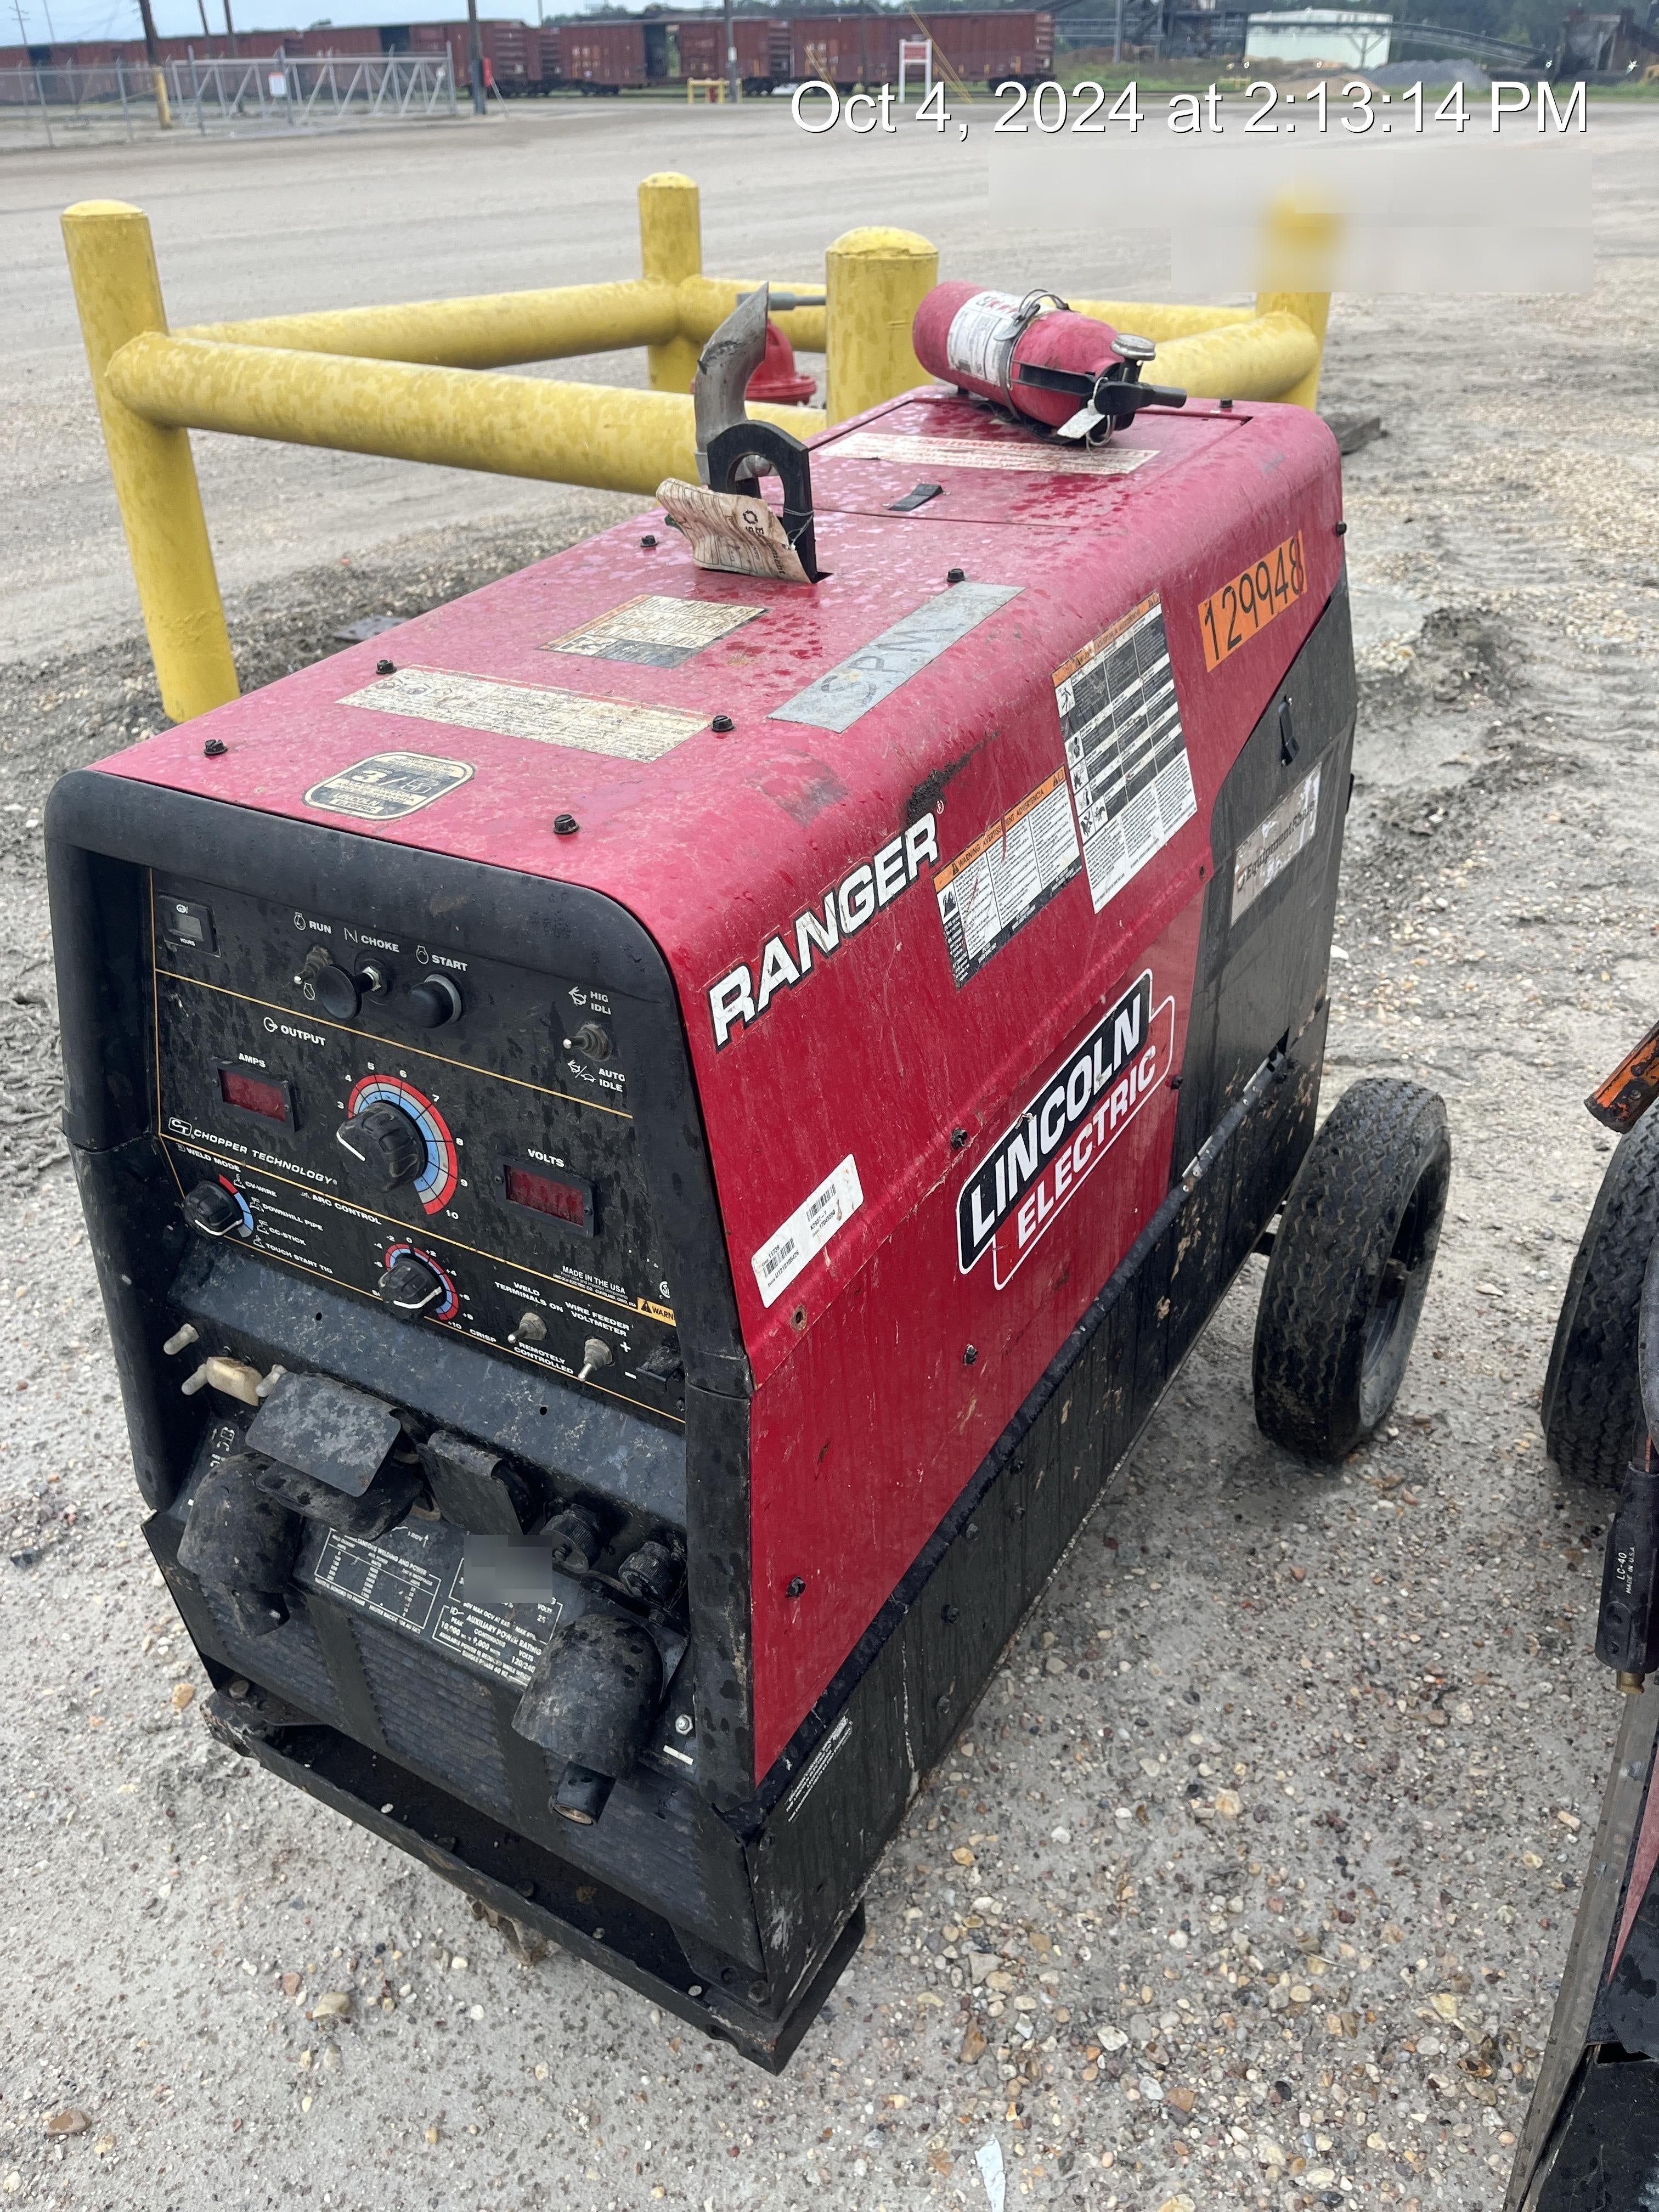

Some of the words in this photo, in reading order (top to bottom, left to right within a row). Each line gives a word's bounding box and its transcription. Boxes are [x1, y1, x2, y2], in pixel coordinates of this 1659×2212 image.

[1205, 538, 1304, 661] 129948
[958, 844, 981, 867] WARNING
[309, 920, 331, 934] RUN
[179, 938, 195, 946] HOURS
[361, 935, 400, 952] CHOKE
[432, 955, 468, 972] START
[590, 991, 608, 1003] HIG
[280, 1025, 326, 1046] OUTPUT
[239, 1053, 266, 1068] AMPS
[367, 1062, 375, 1070] 5
[345, 1074, 352, 1082] 4
[399, 1070, 407, 1078] 6
[598, 1068, 625, 1082] AUTO
[599, 1079, 623, 1092] IDLE
[337, 1101, 344, 1109] 3
[432, 1094, 440, 1102] 7
[970, 992, 1141, 1248] LINCOLN
[194, 1128, 248, 1154] CHOPPER
[456, 1137, 464, 1146] 8
[1018, 1045, 1156, 1249] ELECTRIC
[187, 1148, 212, 1162] WELD
[213, 1157, 241, 1172] MODE
[527, 1148, 565, 1167] VOLTS
[245, 1181, 278, 1197] CV-WIRE
[460, 1179, 468, 1187] 9
[262, 1203, 303, 1223] DOWNHILL
[304, 1220, 324, 1231] PIPE
[312, 1195, 332, 1207] ARC
[334, 1202, 382, 1226] CONTROL
[445, 1210, 459, 1220] 10
[269, 1227, 306, 1246] CC-STICK
[266, 1242, 292, 1258] TOUCH
[293, 1254, 317, 1267] START
[319, 1263, 333, 1274] TIG
[562, 1265, 584, 1280] MADE
[585, 1274, 592, 1282] IN
[594, 1277, 608, 1288] THE
[610, 1283, 626, 1295] USA
[494, 1282, 548, 1306] TERMINALS
[549, 1302, 563, 1312] ON
[513, 1282, 540, 1296] WELD
[565, 1301, 590, 1316] WIRE
[592, 1312, 630, 1331] FEEDER
[652, 1306, 674, 1321] WARN
[448, 1321, 462, 1329] +10
[571, 1310, 627, 1337] VOLTMETER
[469, 1329, 497, 1342] CRISP
[514, 1346, 574, 1374] CONTROLLED
[518, 1342, 566, 1364] REMOTELY
[398, 1558, 409, 1567] AND
[1616, 1552, 1627, 1580] LC-40
[1628, 1565, 1633, 1573] IN
[466, 1615, 497, 1633] AUXILIARY
[496, 1628, 519, 1644] POWER
[519, 1640, 542, 1656] RATING
[473, 1628, 506, 1648] CONTINUOUS
